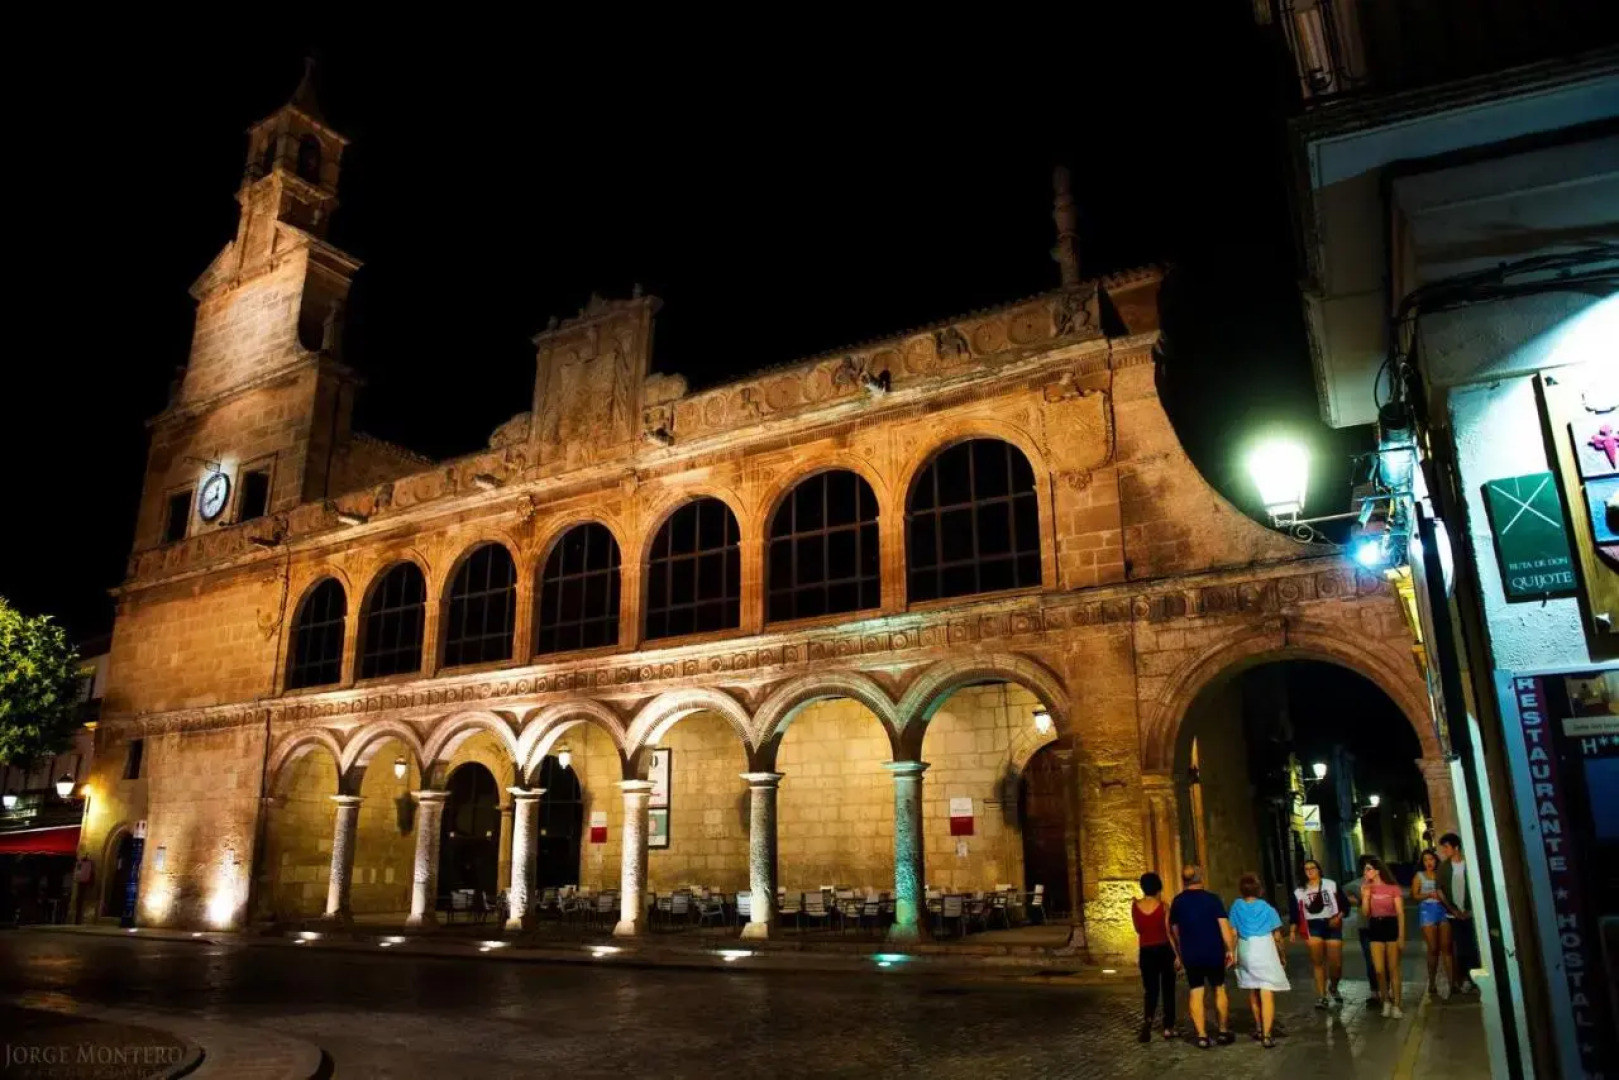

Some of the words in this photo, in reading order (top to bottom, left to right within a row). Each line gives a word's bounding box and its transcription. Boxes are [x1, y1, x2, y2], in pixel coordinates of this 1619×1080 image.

[1509, 561, 1533, 570] RUTA
[1534, 560, 1546, 568] DE
[1547, 556, 1568, 566] DON
[1512, 571, 1573, 590] QUIJOTE
[1516, 677, 1567, 871] RESTAURANTE
[1558, 914, 1594, 1028] HOSTAL
